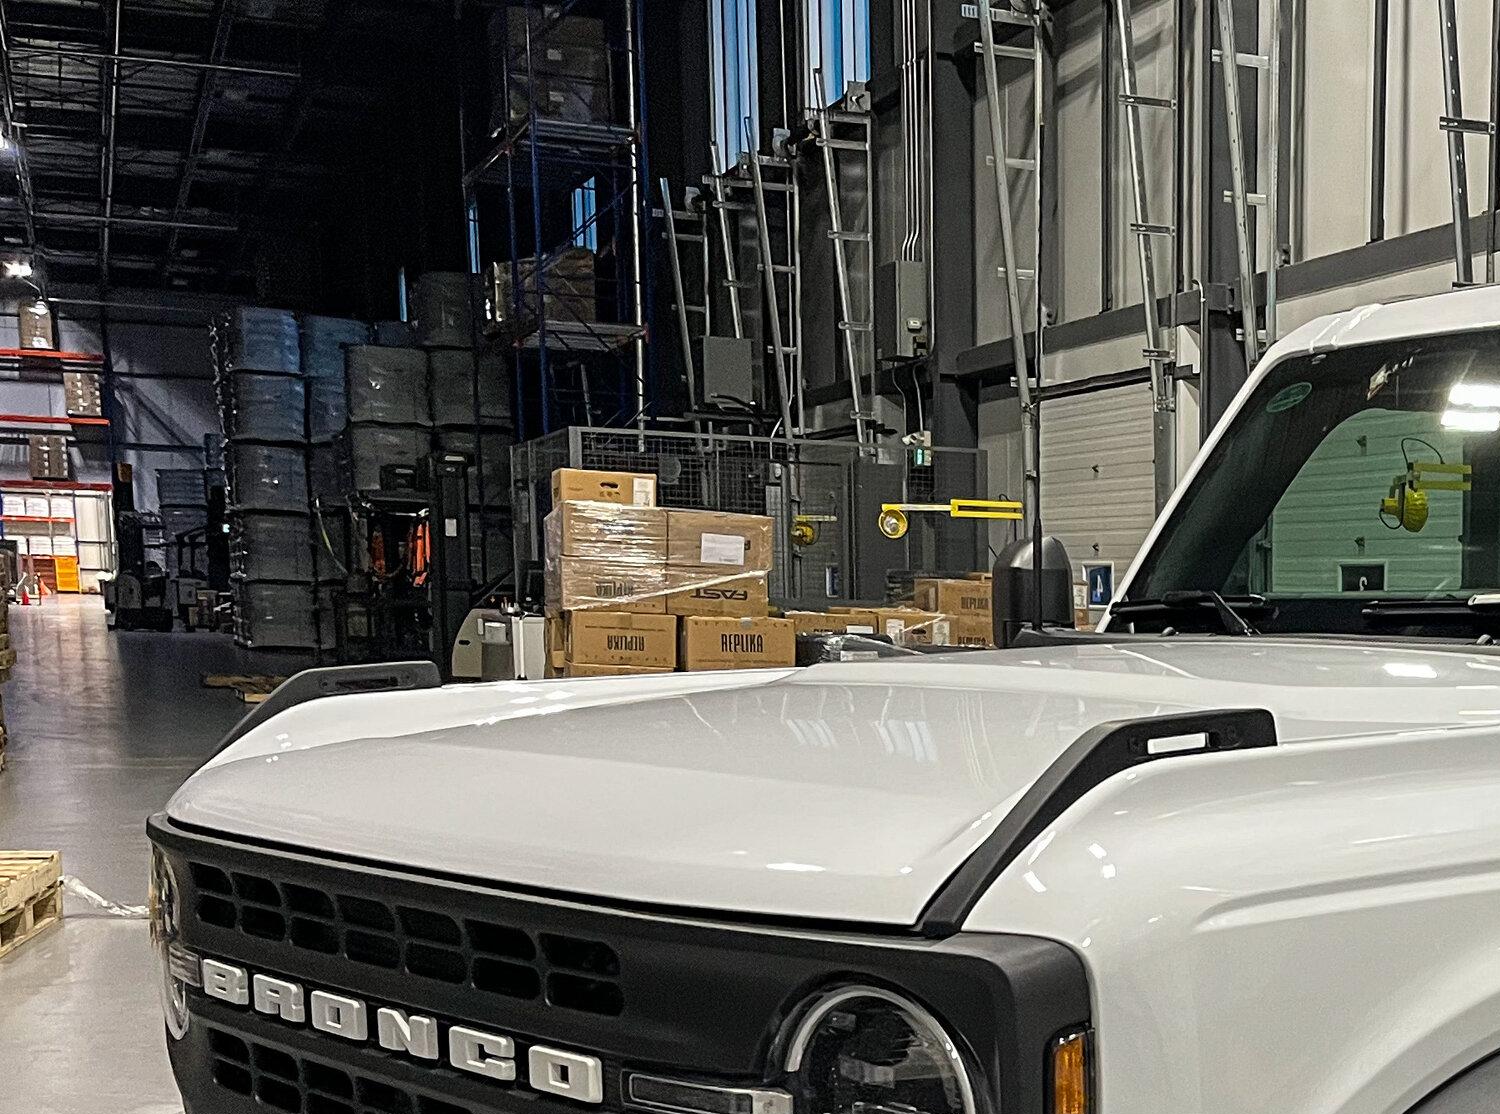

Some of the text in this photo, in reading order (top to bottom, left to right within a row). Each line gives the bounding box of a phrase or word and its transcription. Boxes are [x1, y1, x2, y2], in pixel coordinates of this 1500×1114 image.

[689, 588, 748, 601] FAST
[607, 634, 645, 651] REPLIKA
[721, 633, 763, 653] REPLIKA
[201, 958, 603, 1104] BRONCO
